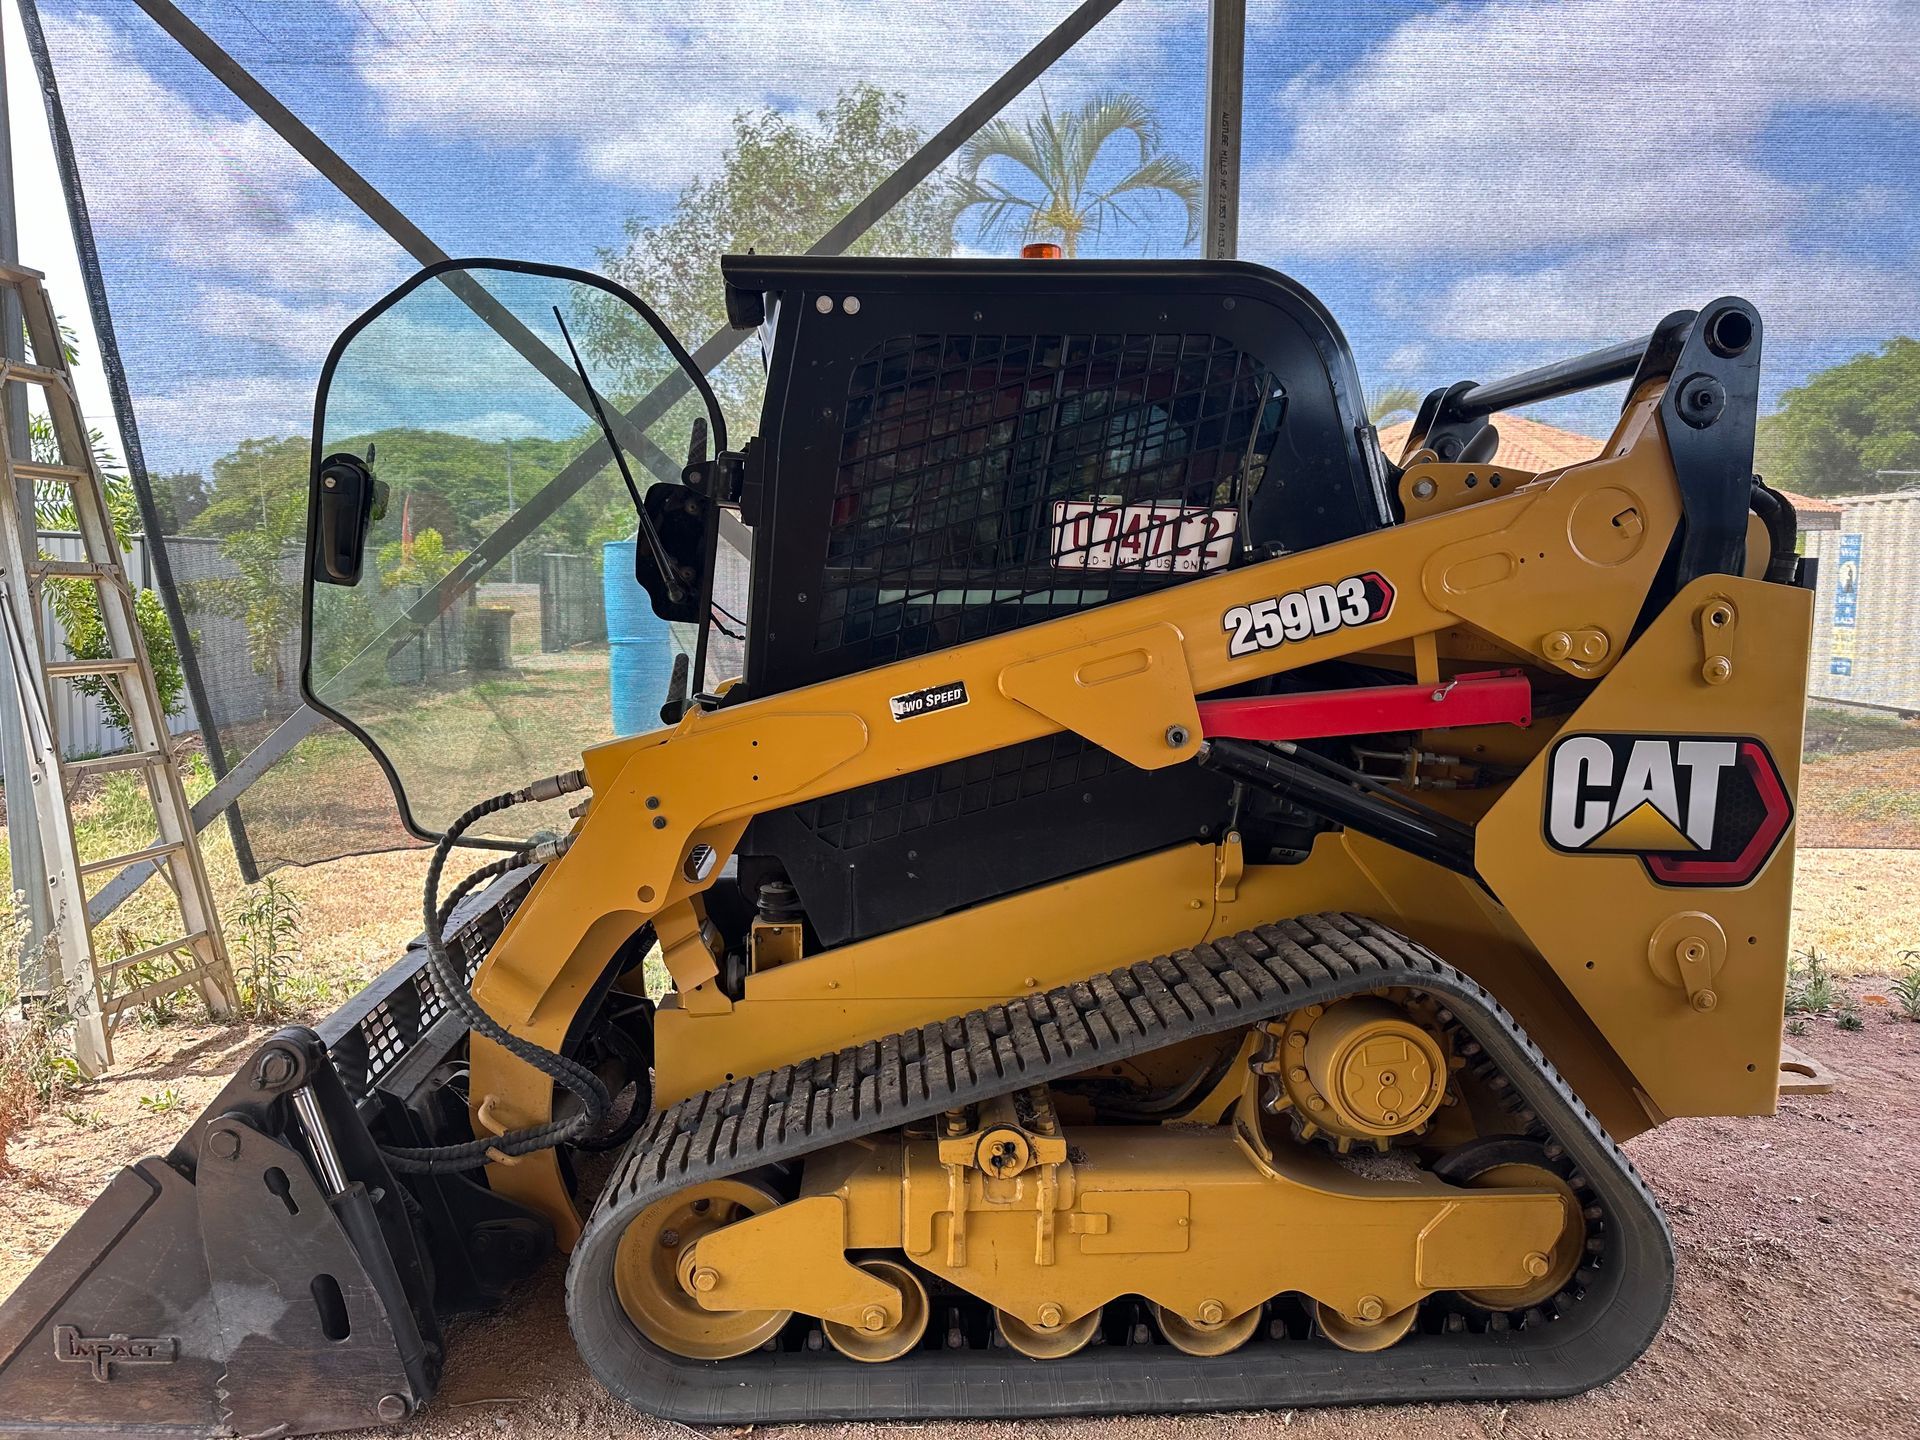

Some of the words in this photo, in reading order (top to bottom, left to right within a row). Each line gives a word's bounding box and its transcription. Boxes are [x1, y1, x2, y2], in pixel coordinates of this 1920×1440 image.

[1220, 150, 1229, 176] MILLS
[1183, 559, 1210, 570] ONY
[1223, 577, 1370, 656] 259D3
[897, 698, 923, 715] TWO
[925, 688, 963, 707] SPEED
[1549, 736, 1738, 851] CAT
[1279, 849, 1296, 857] CAT
[68, 1332, 158, 1375] IMPACT
